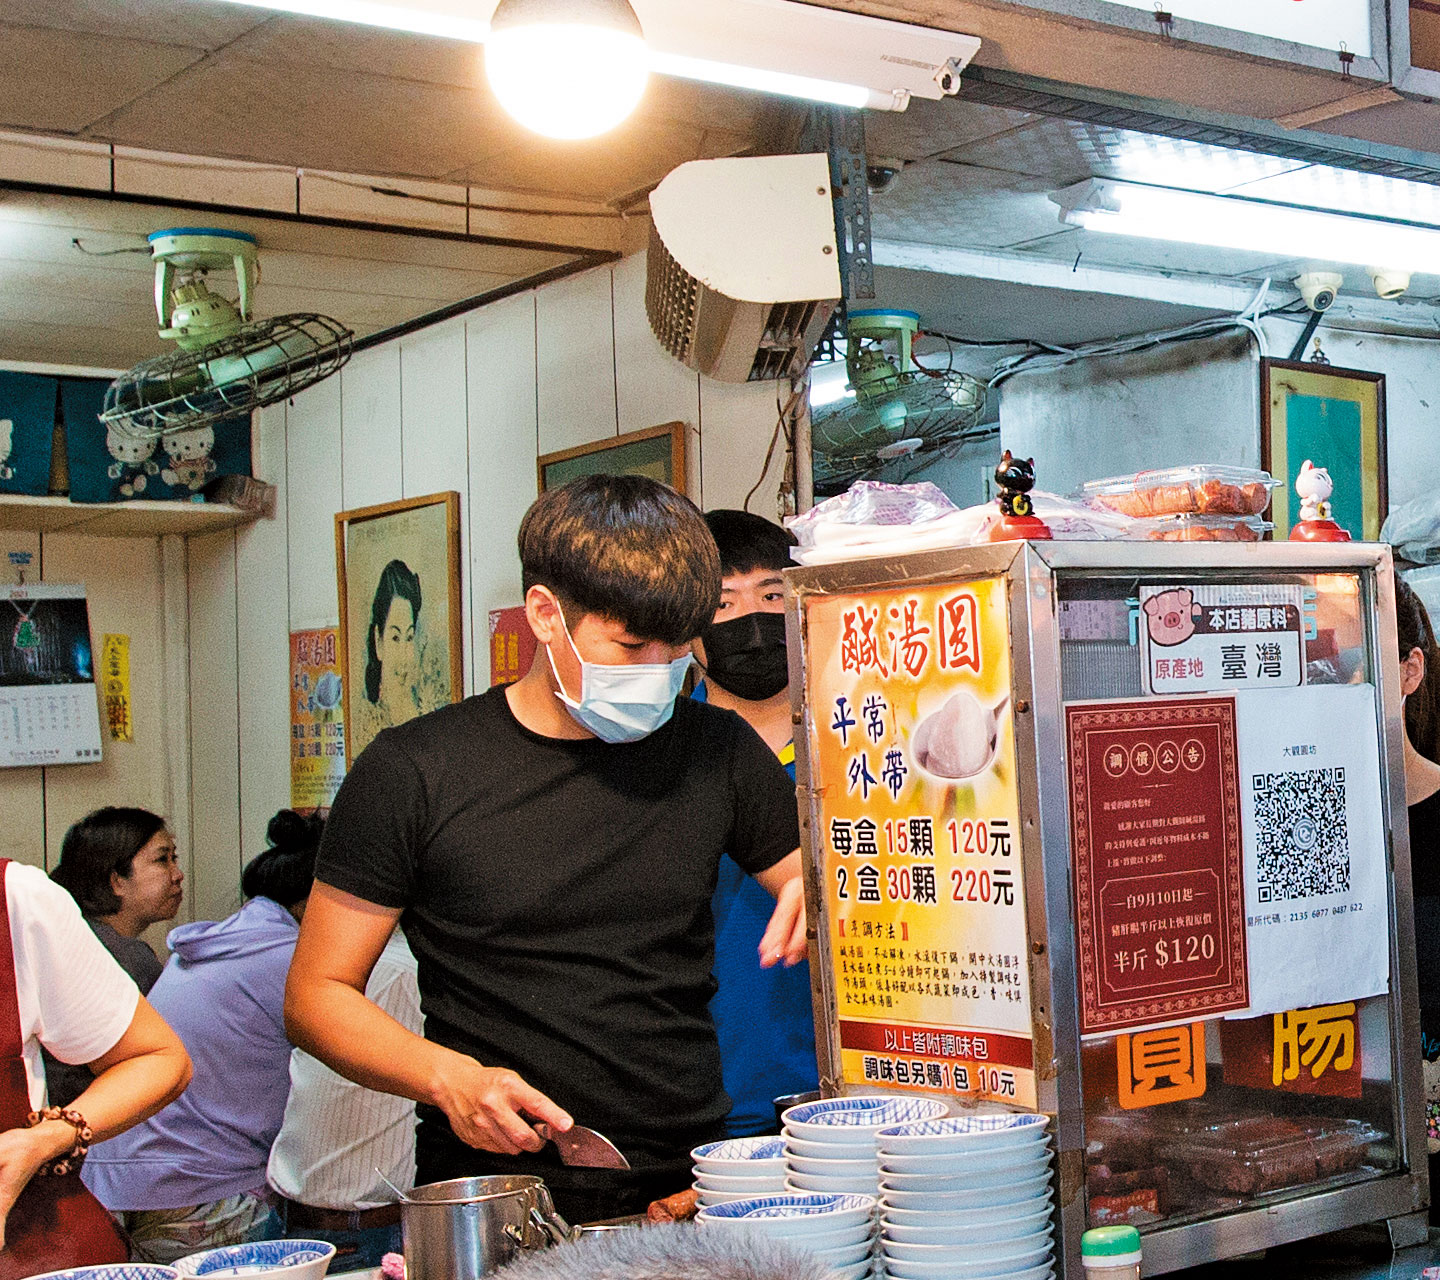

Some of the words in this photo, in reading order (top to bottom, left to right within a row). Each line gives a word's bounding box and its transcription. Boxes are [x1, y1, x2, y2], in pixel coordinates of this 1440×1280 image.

[841, 593, 981, 679] 鹹湯圓
[1208, 606, 1288, 631] 本店豬原料
[1154, 657, 1205, 680] 原產地
[1220, 642, 1282, 681] 臺灣
[832, 695, 887, 745] 平常
[848, 750, 908, 800] 外帶
[1109, 746, 1200, 769] 調價公告
[948, 819, 1011, 858] 120元
[951, 869, 1014, 906] 220元
[1126, 887, 1194, 910] 自9月10日起
[1112, 948, 1148, 975] 半斤
[1154, 933, 1216, 970] $120
[884, 1028, 989, 1060] 以上皆附調味包
[976, 1066, 1016, 1097] 10元
